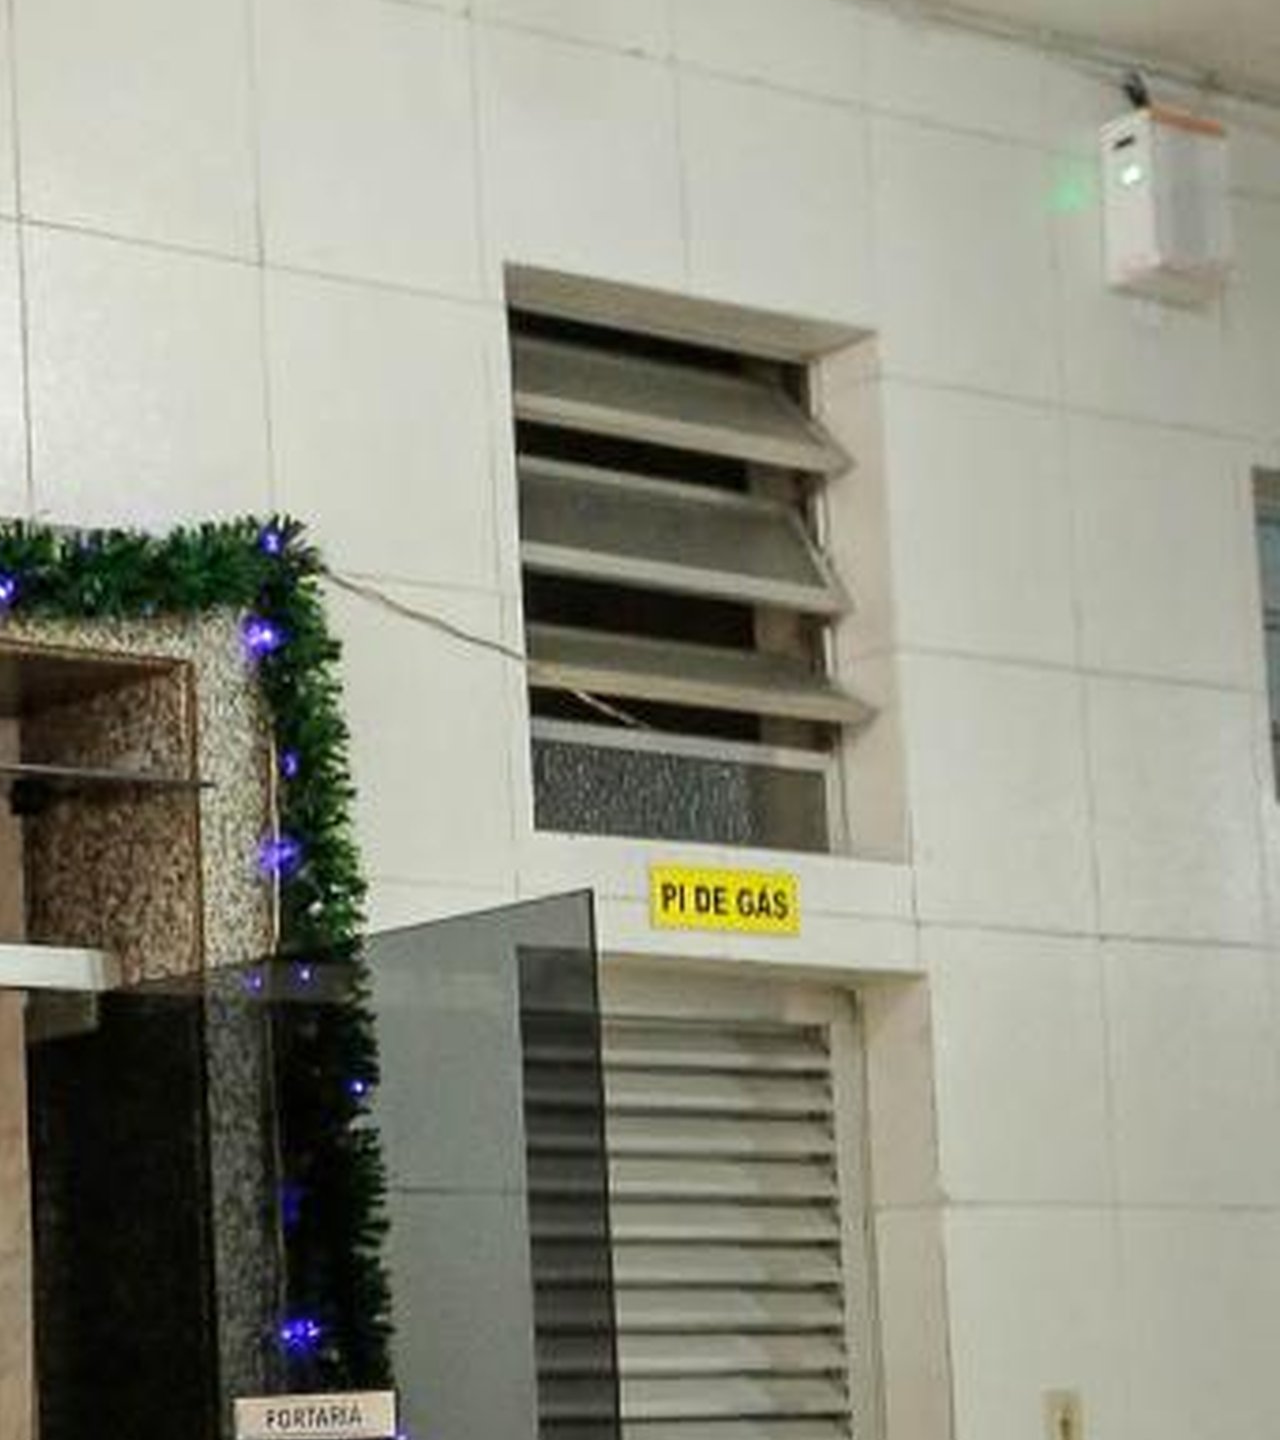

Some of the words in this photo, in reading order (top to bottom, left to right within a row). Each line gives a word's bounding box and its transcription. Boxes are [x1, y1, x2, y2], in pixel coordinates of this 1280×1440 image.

[660, 882, 686, 913] PI
[694, 885, 728, 916] DE
[265, 1403, 363, 1429] PORTARIA
